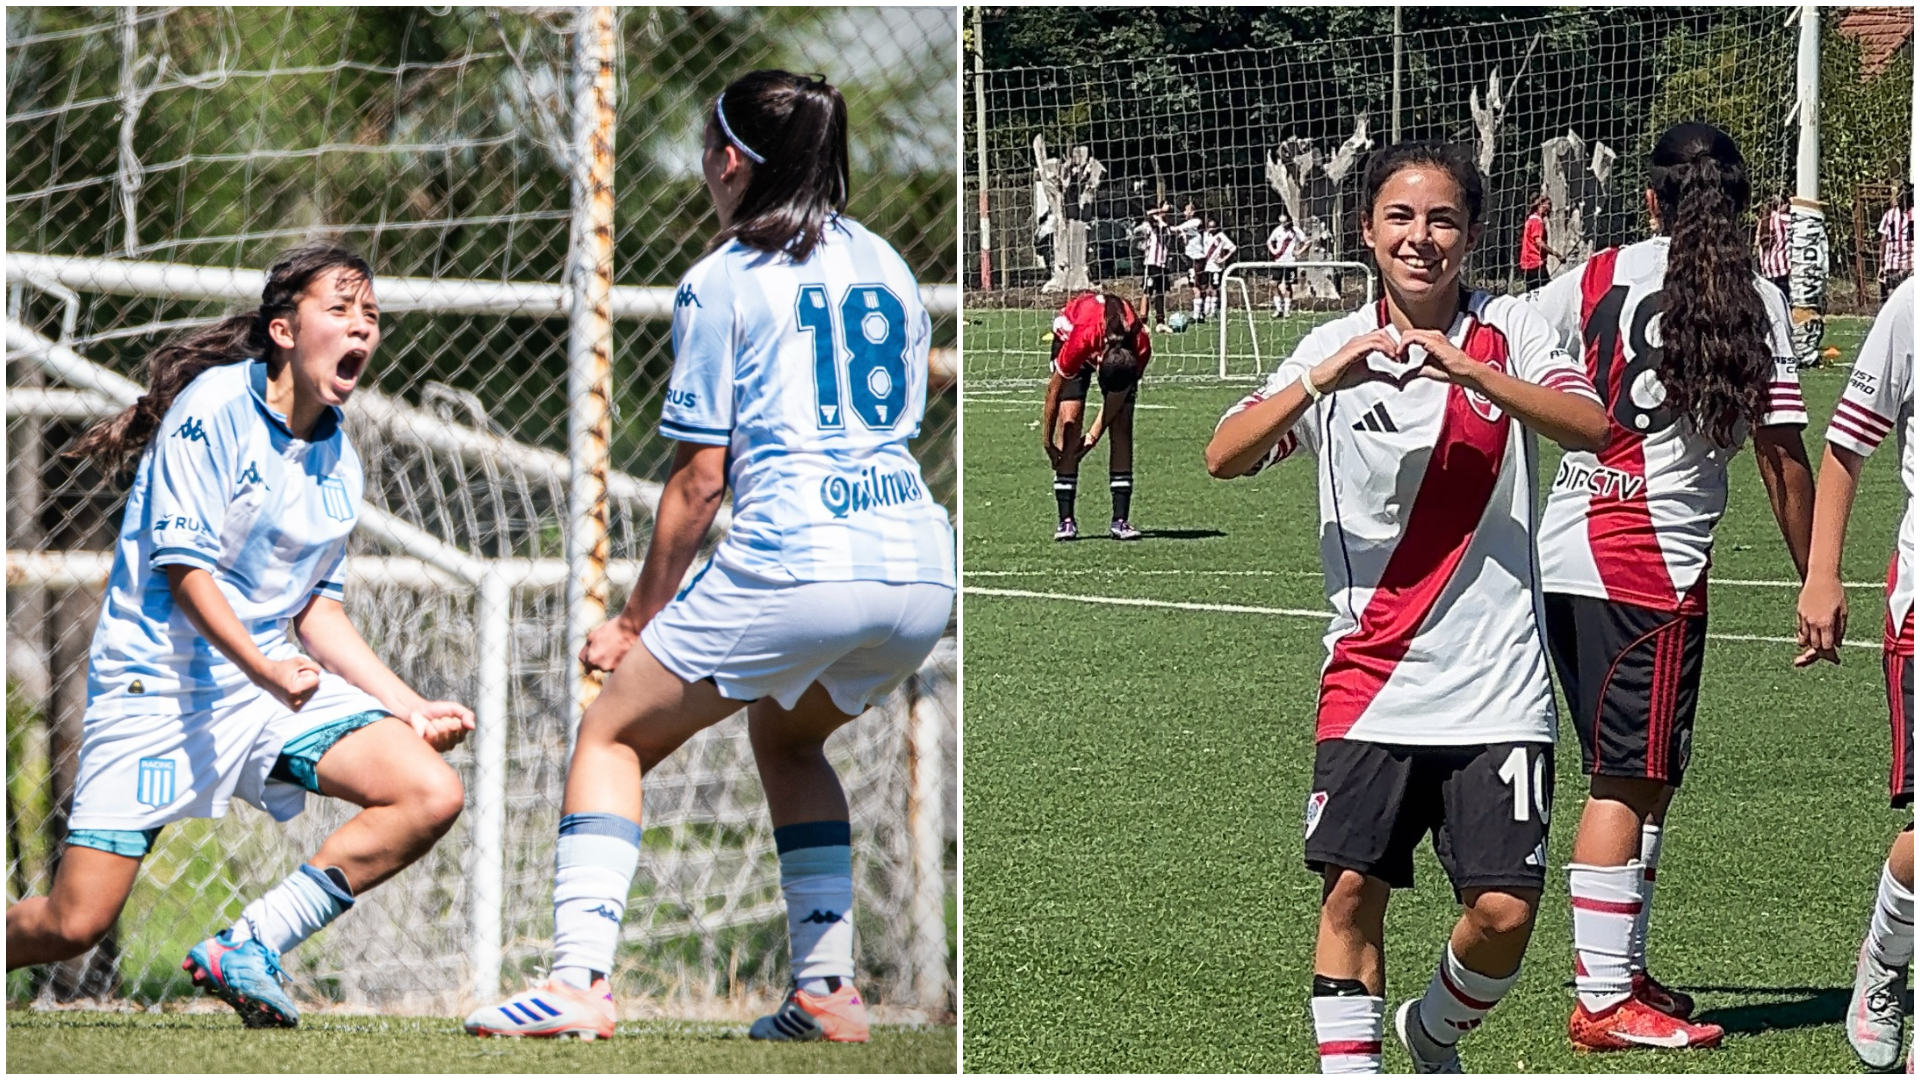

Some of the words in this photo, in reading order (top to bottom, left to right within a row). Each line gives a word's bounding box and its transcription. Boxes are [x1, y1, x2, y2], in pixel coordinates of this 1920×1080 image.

[794, 283, 910, 431] 18
[1584, 284, 1686, 434] 18
[1557, 461, 1642, 500] DIRCTV
[1498, 746, 1550, 825] 10
